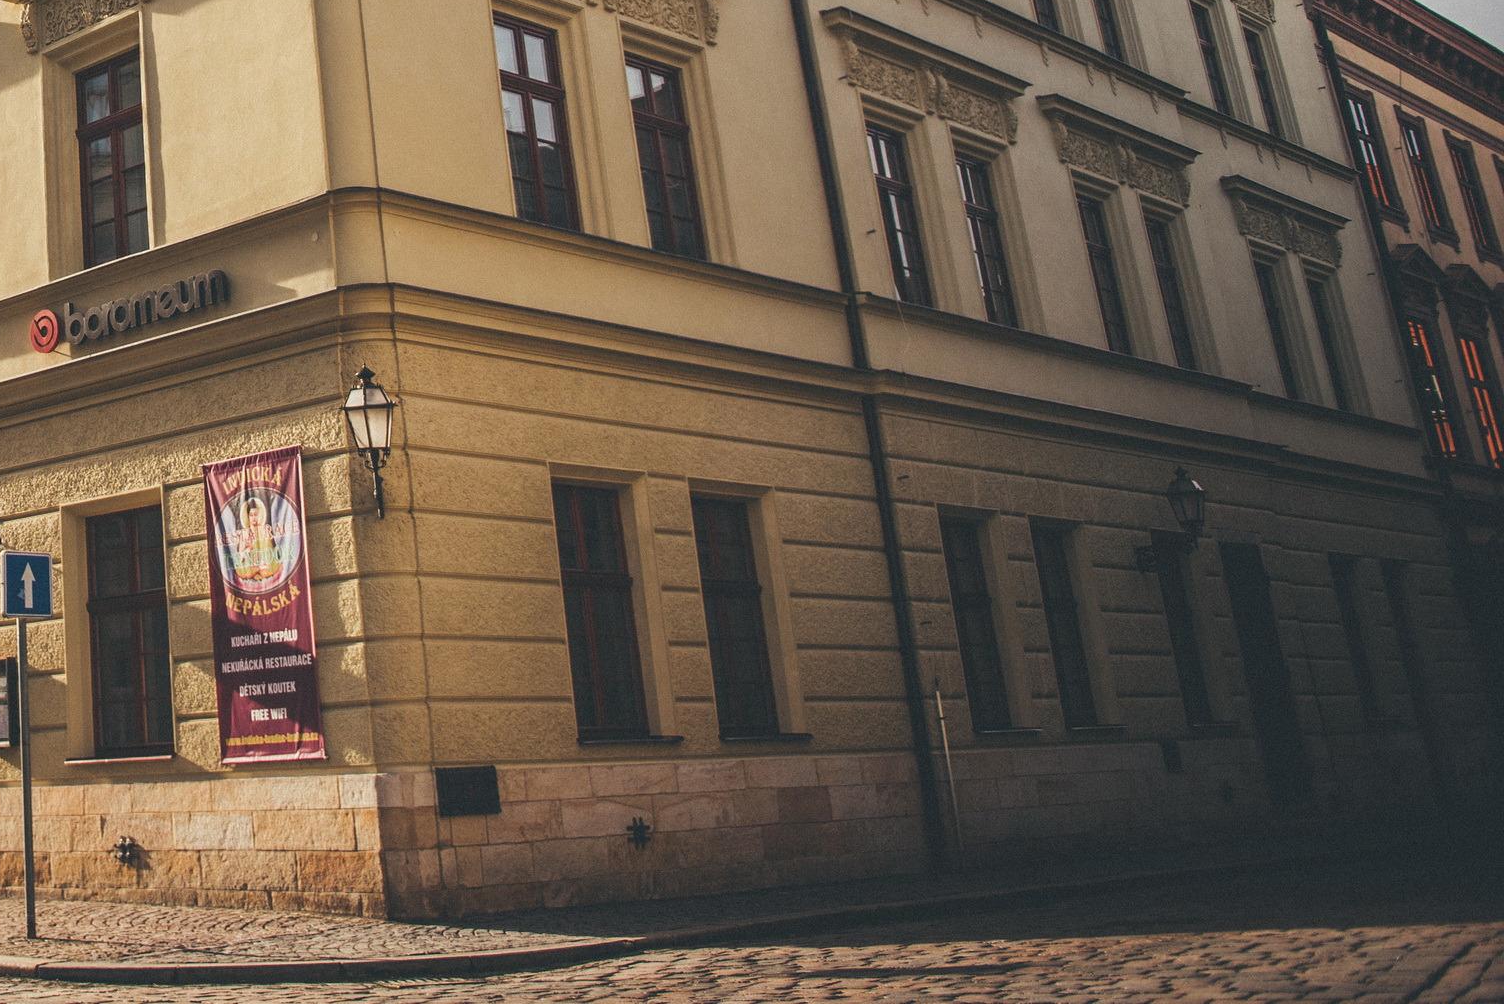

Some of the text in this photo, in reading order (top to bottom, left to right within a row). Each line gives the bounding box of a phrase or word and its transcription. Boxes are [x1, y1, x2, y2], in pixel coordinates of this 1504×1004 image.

[64, 269, 229, 345] baromeum
[225, 580, 301, 617] NEPÁLSKÁ
[269, 627, 298, 643] NEPÁLU
[265, 653, 312, 670] RESTAURACE
[267, 680, 296, 694] KOUTEK
[250, 707, 288, 722] FREE WIFI
